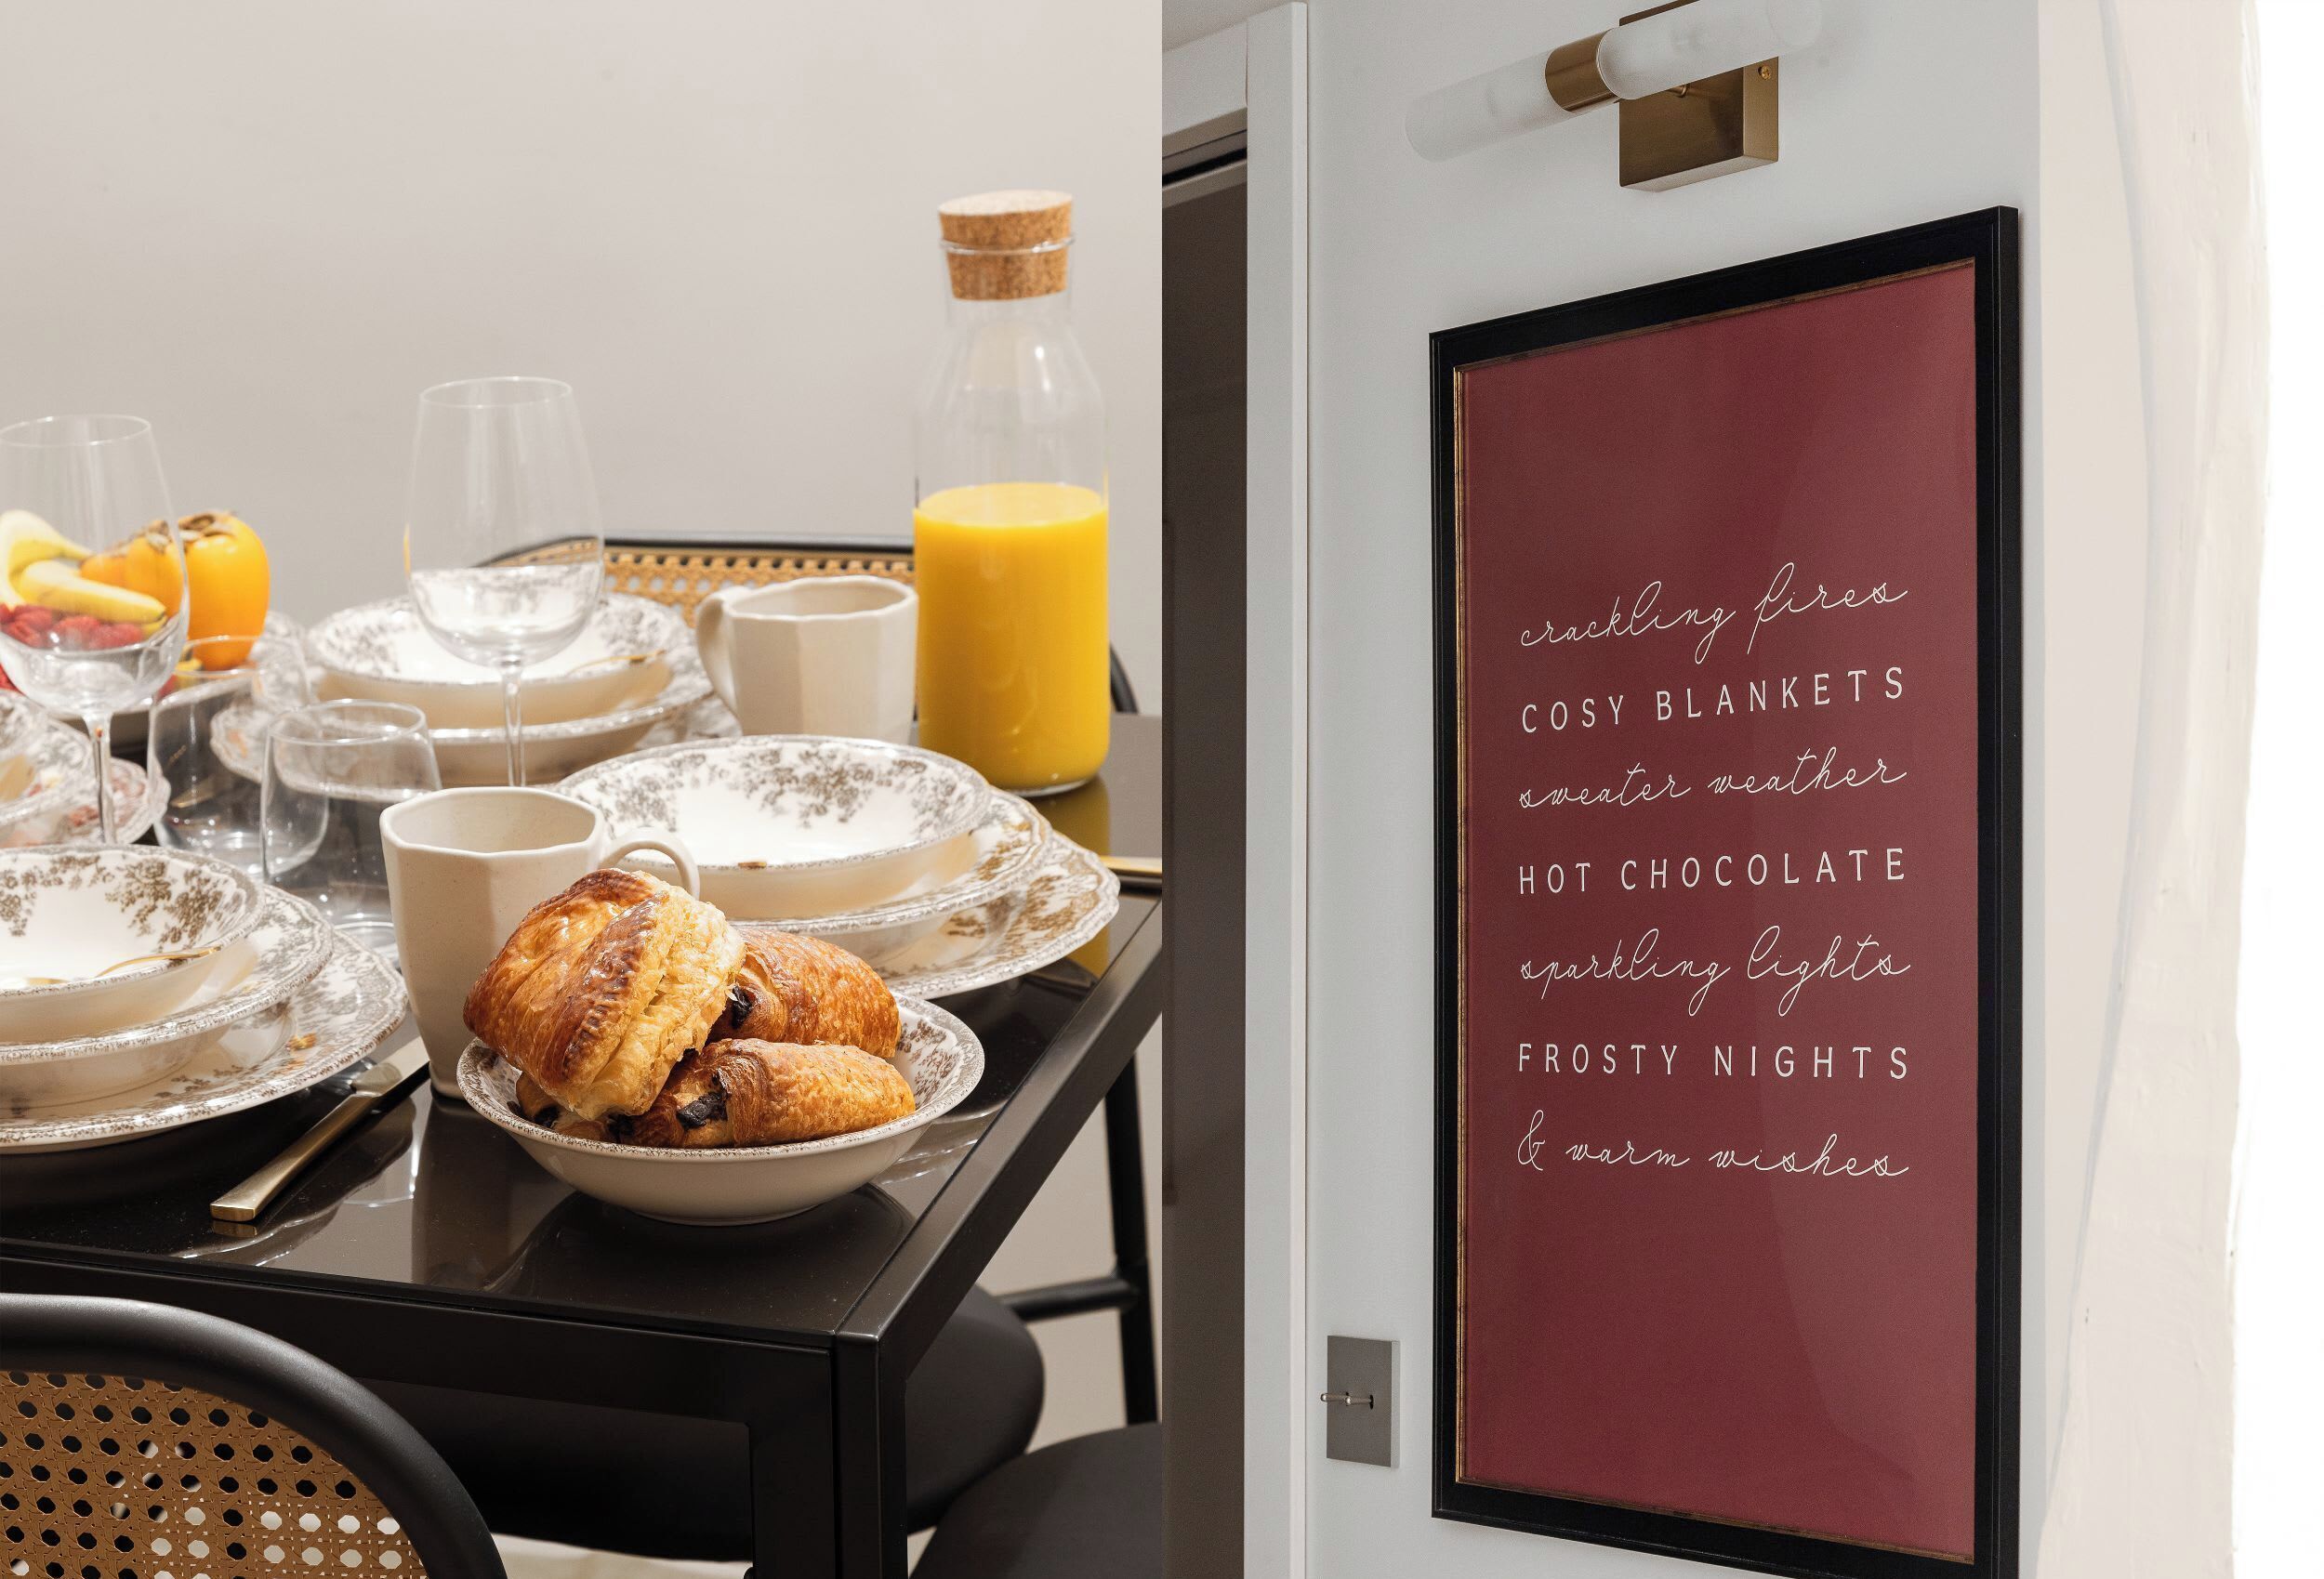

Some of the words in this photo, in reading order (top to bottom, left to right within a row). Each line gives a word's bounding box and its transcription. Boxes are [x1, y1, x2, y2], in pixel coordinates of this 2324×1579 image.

[1521, 581, 1736, 664] crackling
[1747, 562, 1908, 655] fires
[1522, 695, 1624, 732] COSY
[1657, 667, 1903, 721] BLANKETS
[1519, 763, 1692, 809] sweater
[1708, 746, 1908, 796] weather
[1520, 862, 1591, 894] HOT
[1620, 848, 1905, 890] CHOCOLATE
[1521, 928, 1731, 1017] sparkling
[1747, 926, 1911, 1017] lights
[1518, 1043, 1678, 1075] FROSTY
[1714, 1046, 1908, 1079] NIGHTS
[1518, 1110, 1546, 1171] &
[1565, 1141, 1690, 1167] warm
[1708, 1134, 1909, 1177] wishes
